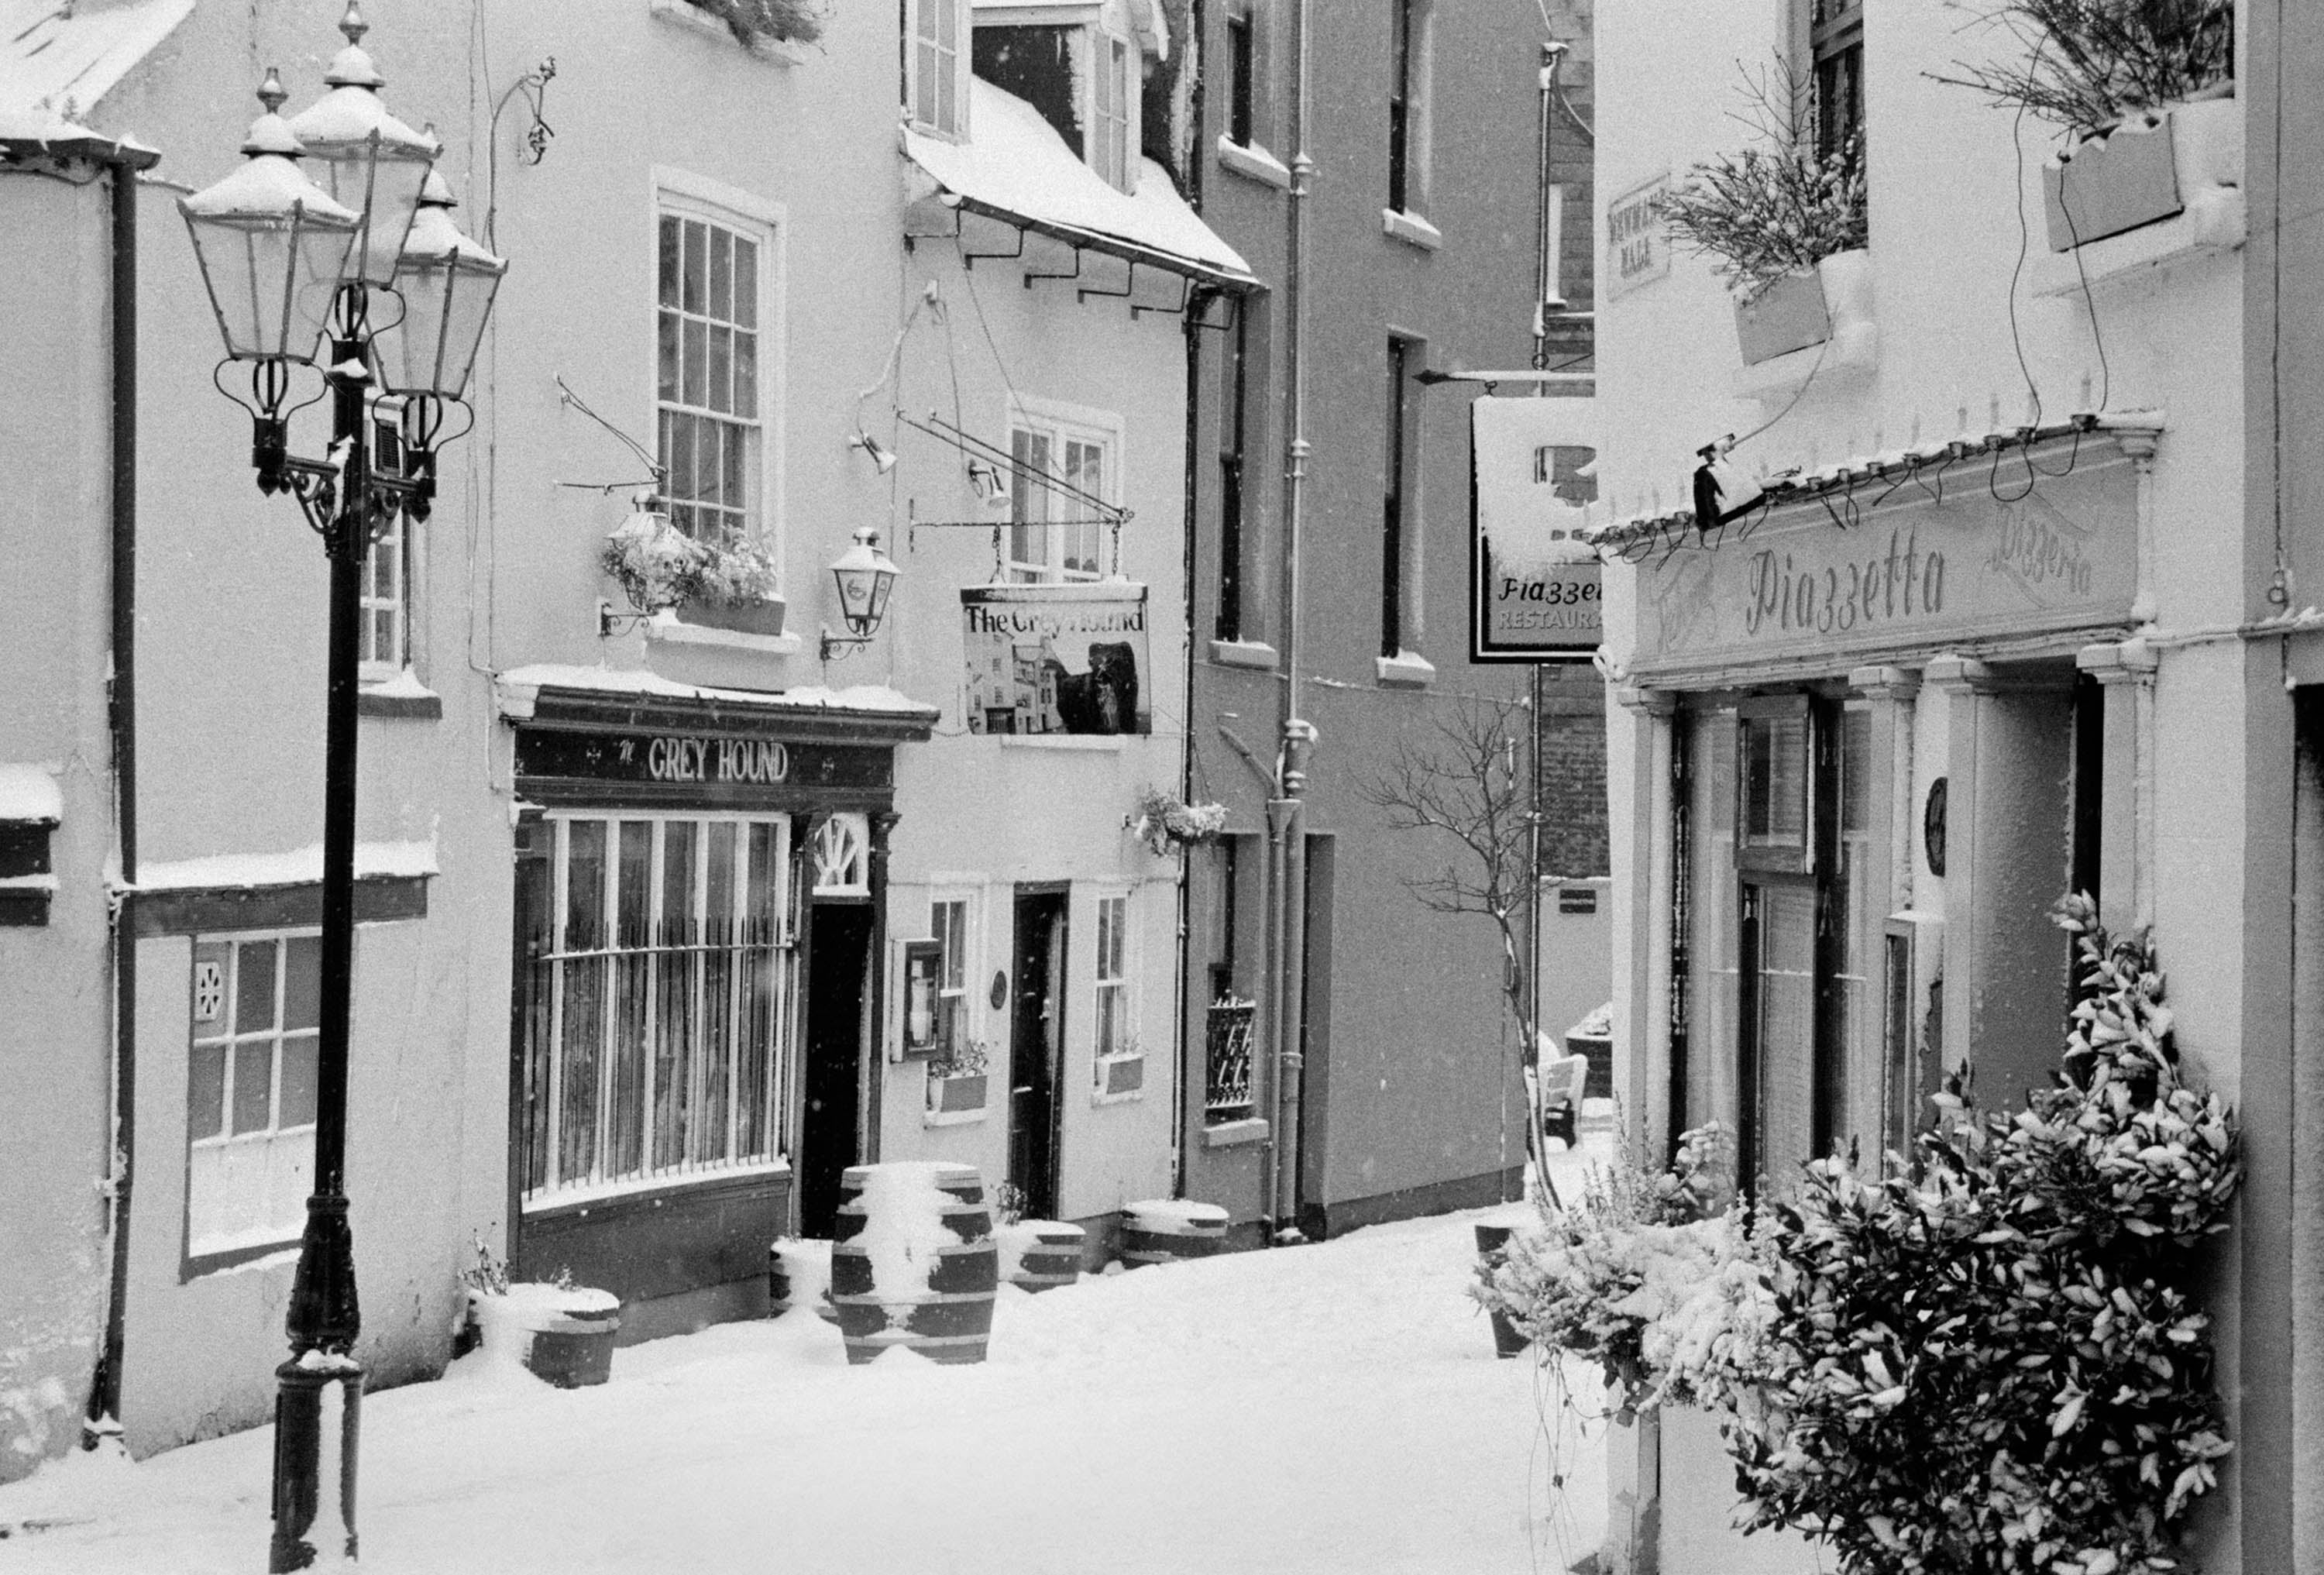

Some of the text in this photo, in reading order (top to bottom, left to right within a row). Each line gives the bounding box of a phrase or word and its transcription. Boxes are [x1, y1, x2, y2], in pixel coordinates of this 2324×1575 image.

[1747, 521, 1944, 635] Piazzetta
[963, 606, 1008, 633] The
[1069, 604, 1143, 632] ound
[649, 738, 709, 781] GREY
[717, 739, 788, 782] HOUND
